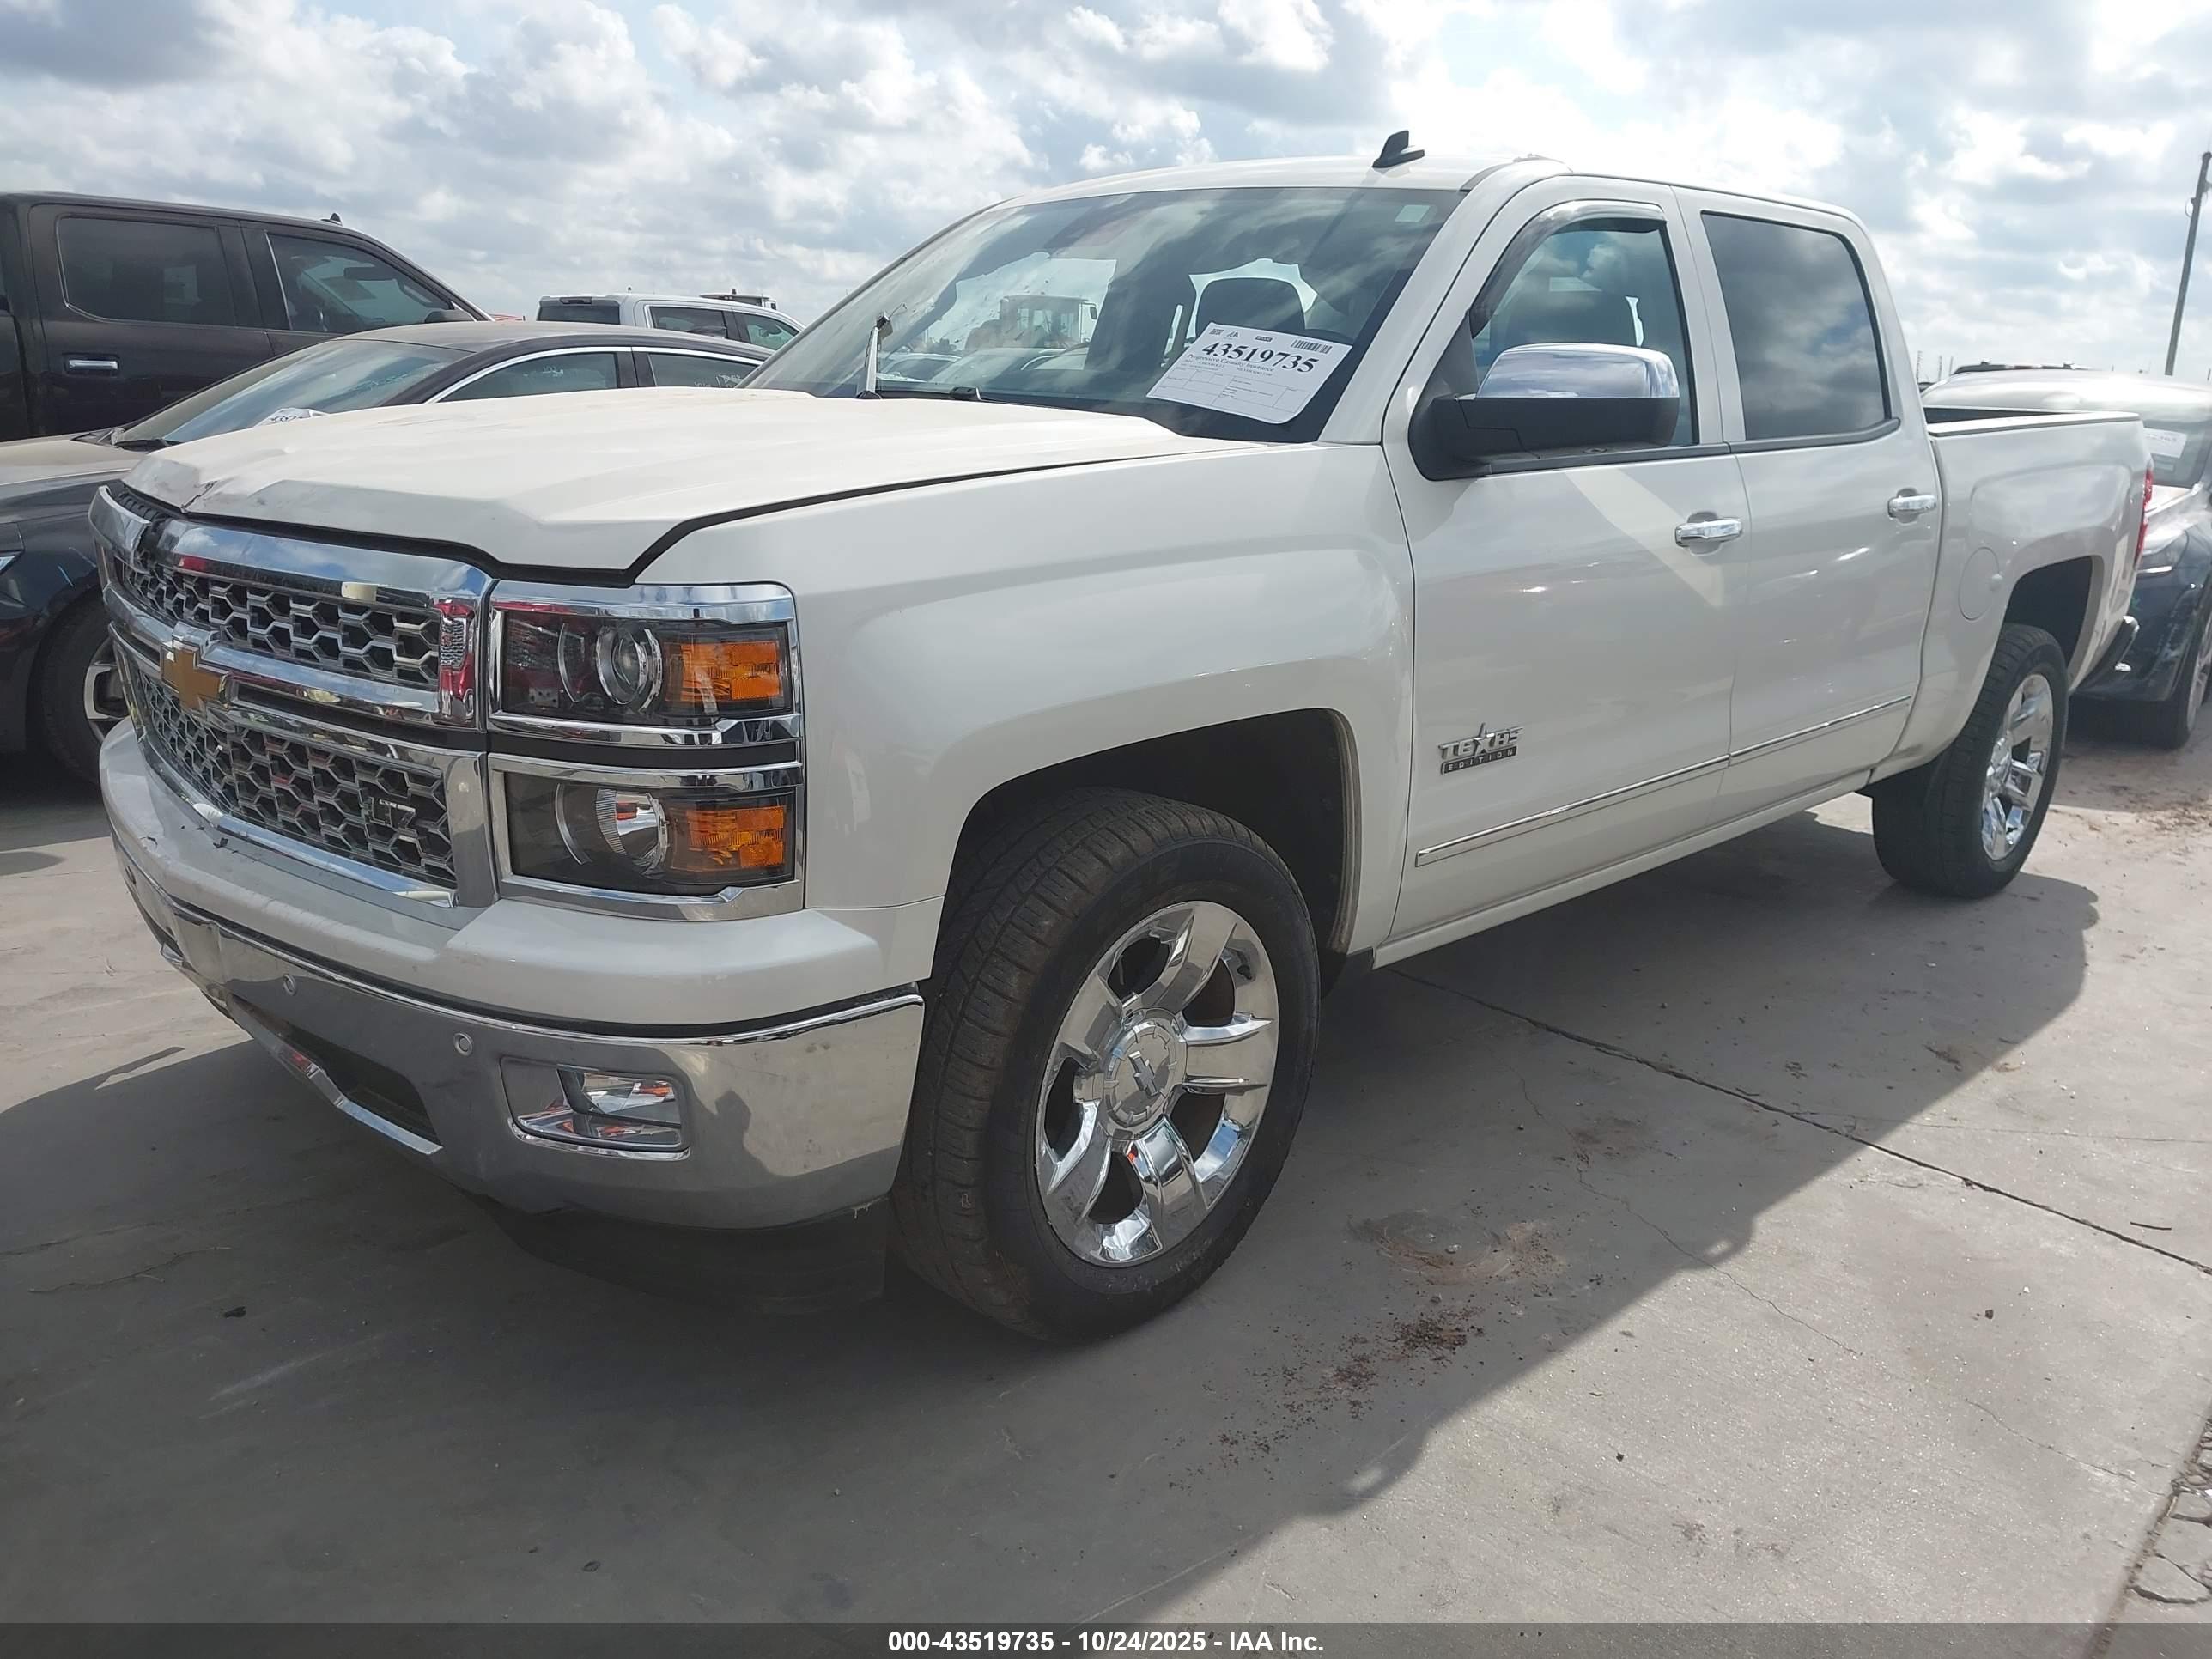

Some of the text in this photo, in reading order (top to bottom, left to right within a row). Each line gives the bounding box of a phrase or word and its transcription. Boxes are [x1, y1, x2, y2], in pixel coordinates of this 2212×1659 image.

[1188, 353, 1220, 363] Progressive
[1220, 357, 1245, 368] Casualty
[1246, 362, 1274, 372] Insurance
[1202, 342, 1319, 374] 43519735
[1438, 724, 1523, 760] TEXAS
[1447, 748, 1513, 771] EDITION
